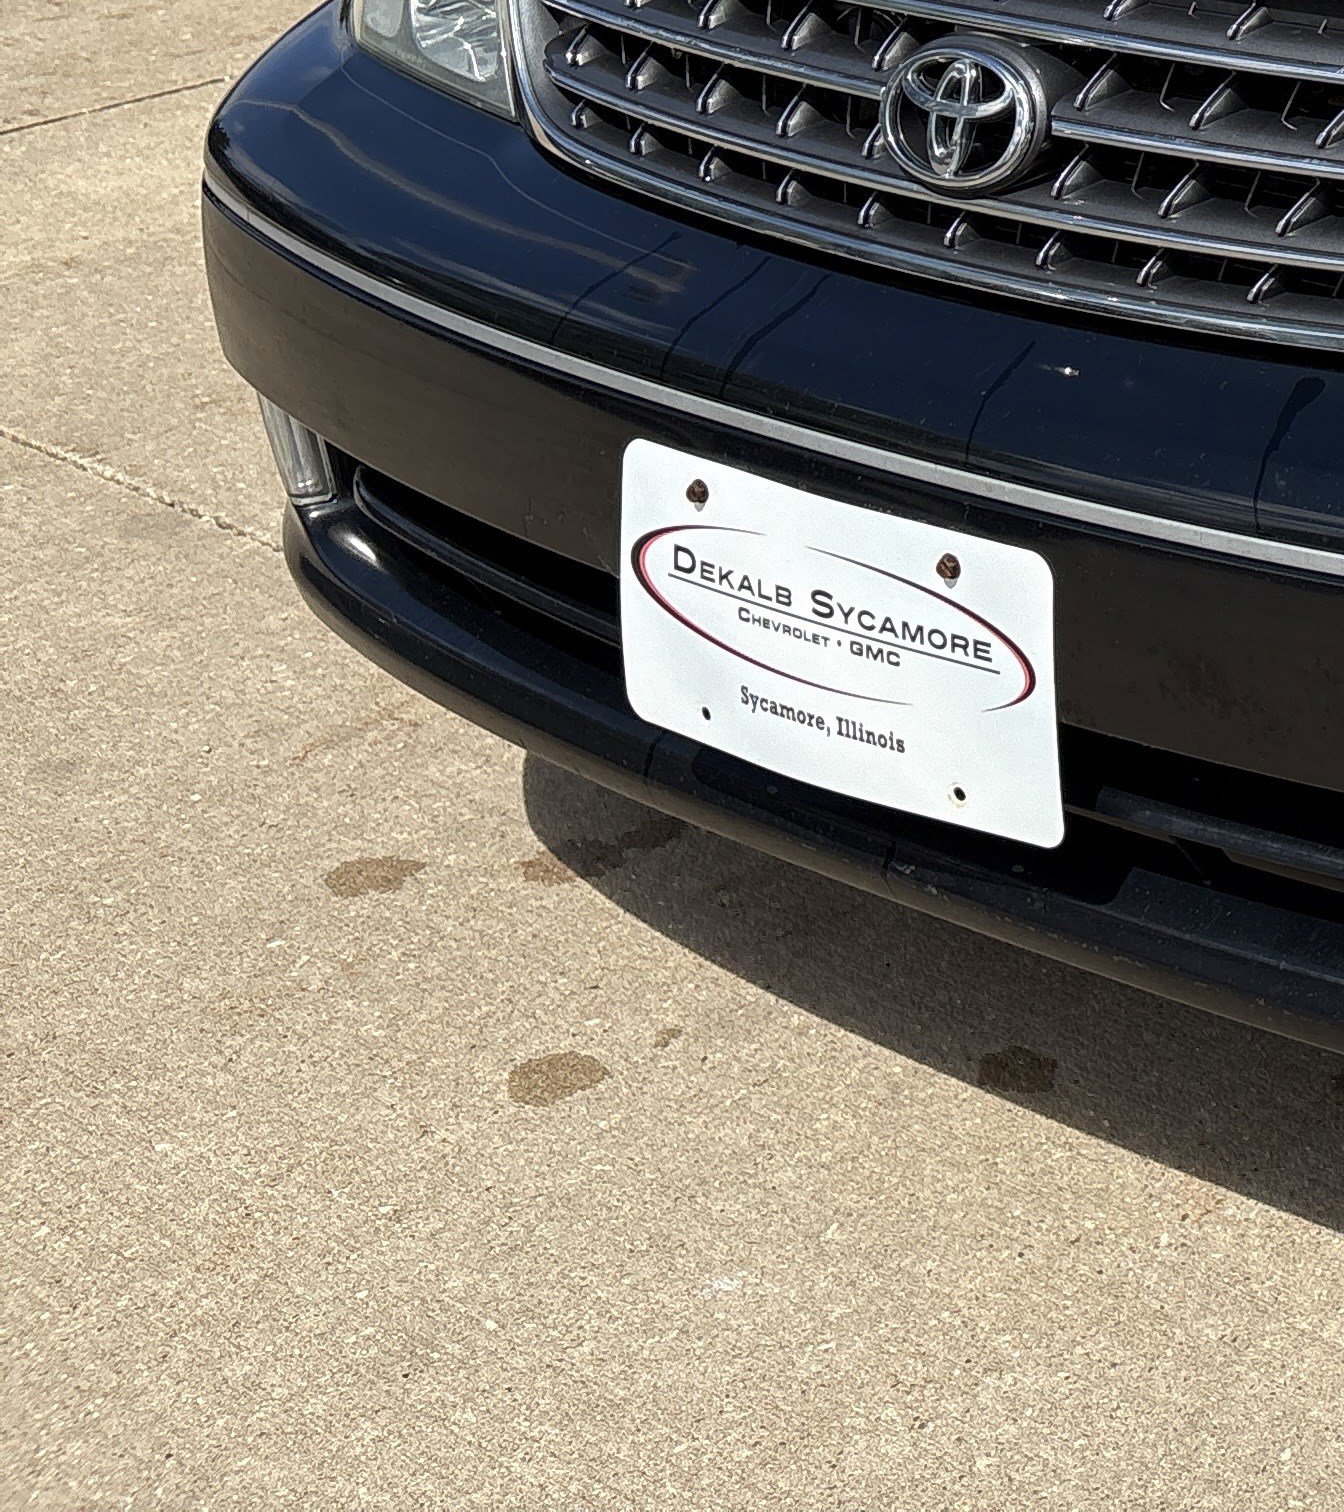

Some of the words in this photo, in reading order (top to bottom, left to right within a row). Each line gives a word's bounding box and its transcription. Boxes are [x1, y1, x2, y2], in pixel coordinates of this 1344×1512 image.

[673, 543, 793, 607] DEKALB
[810, 589, 993, 663] SYCAMORE
[737, 607, 830, 648] CHEVROLET
[849, 640, 901, 667] GMC
[740, 685, 831, 738] Sycamore,
[836, 716, 905, 754] Illinois
